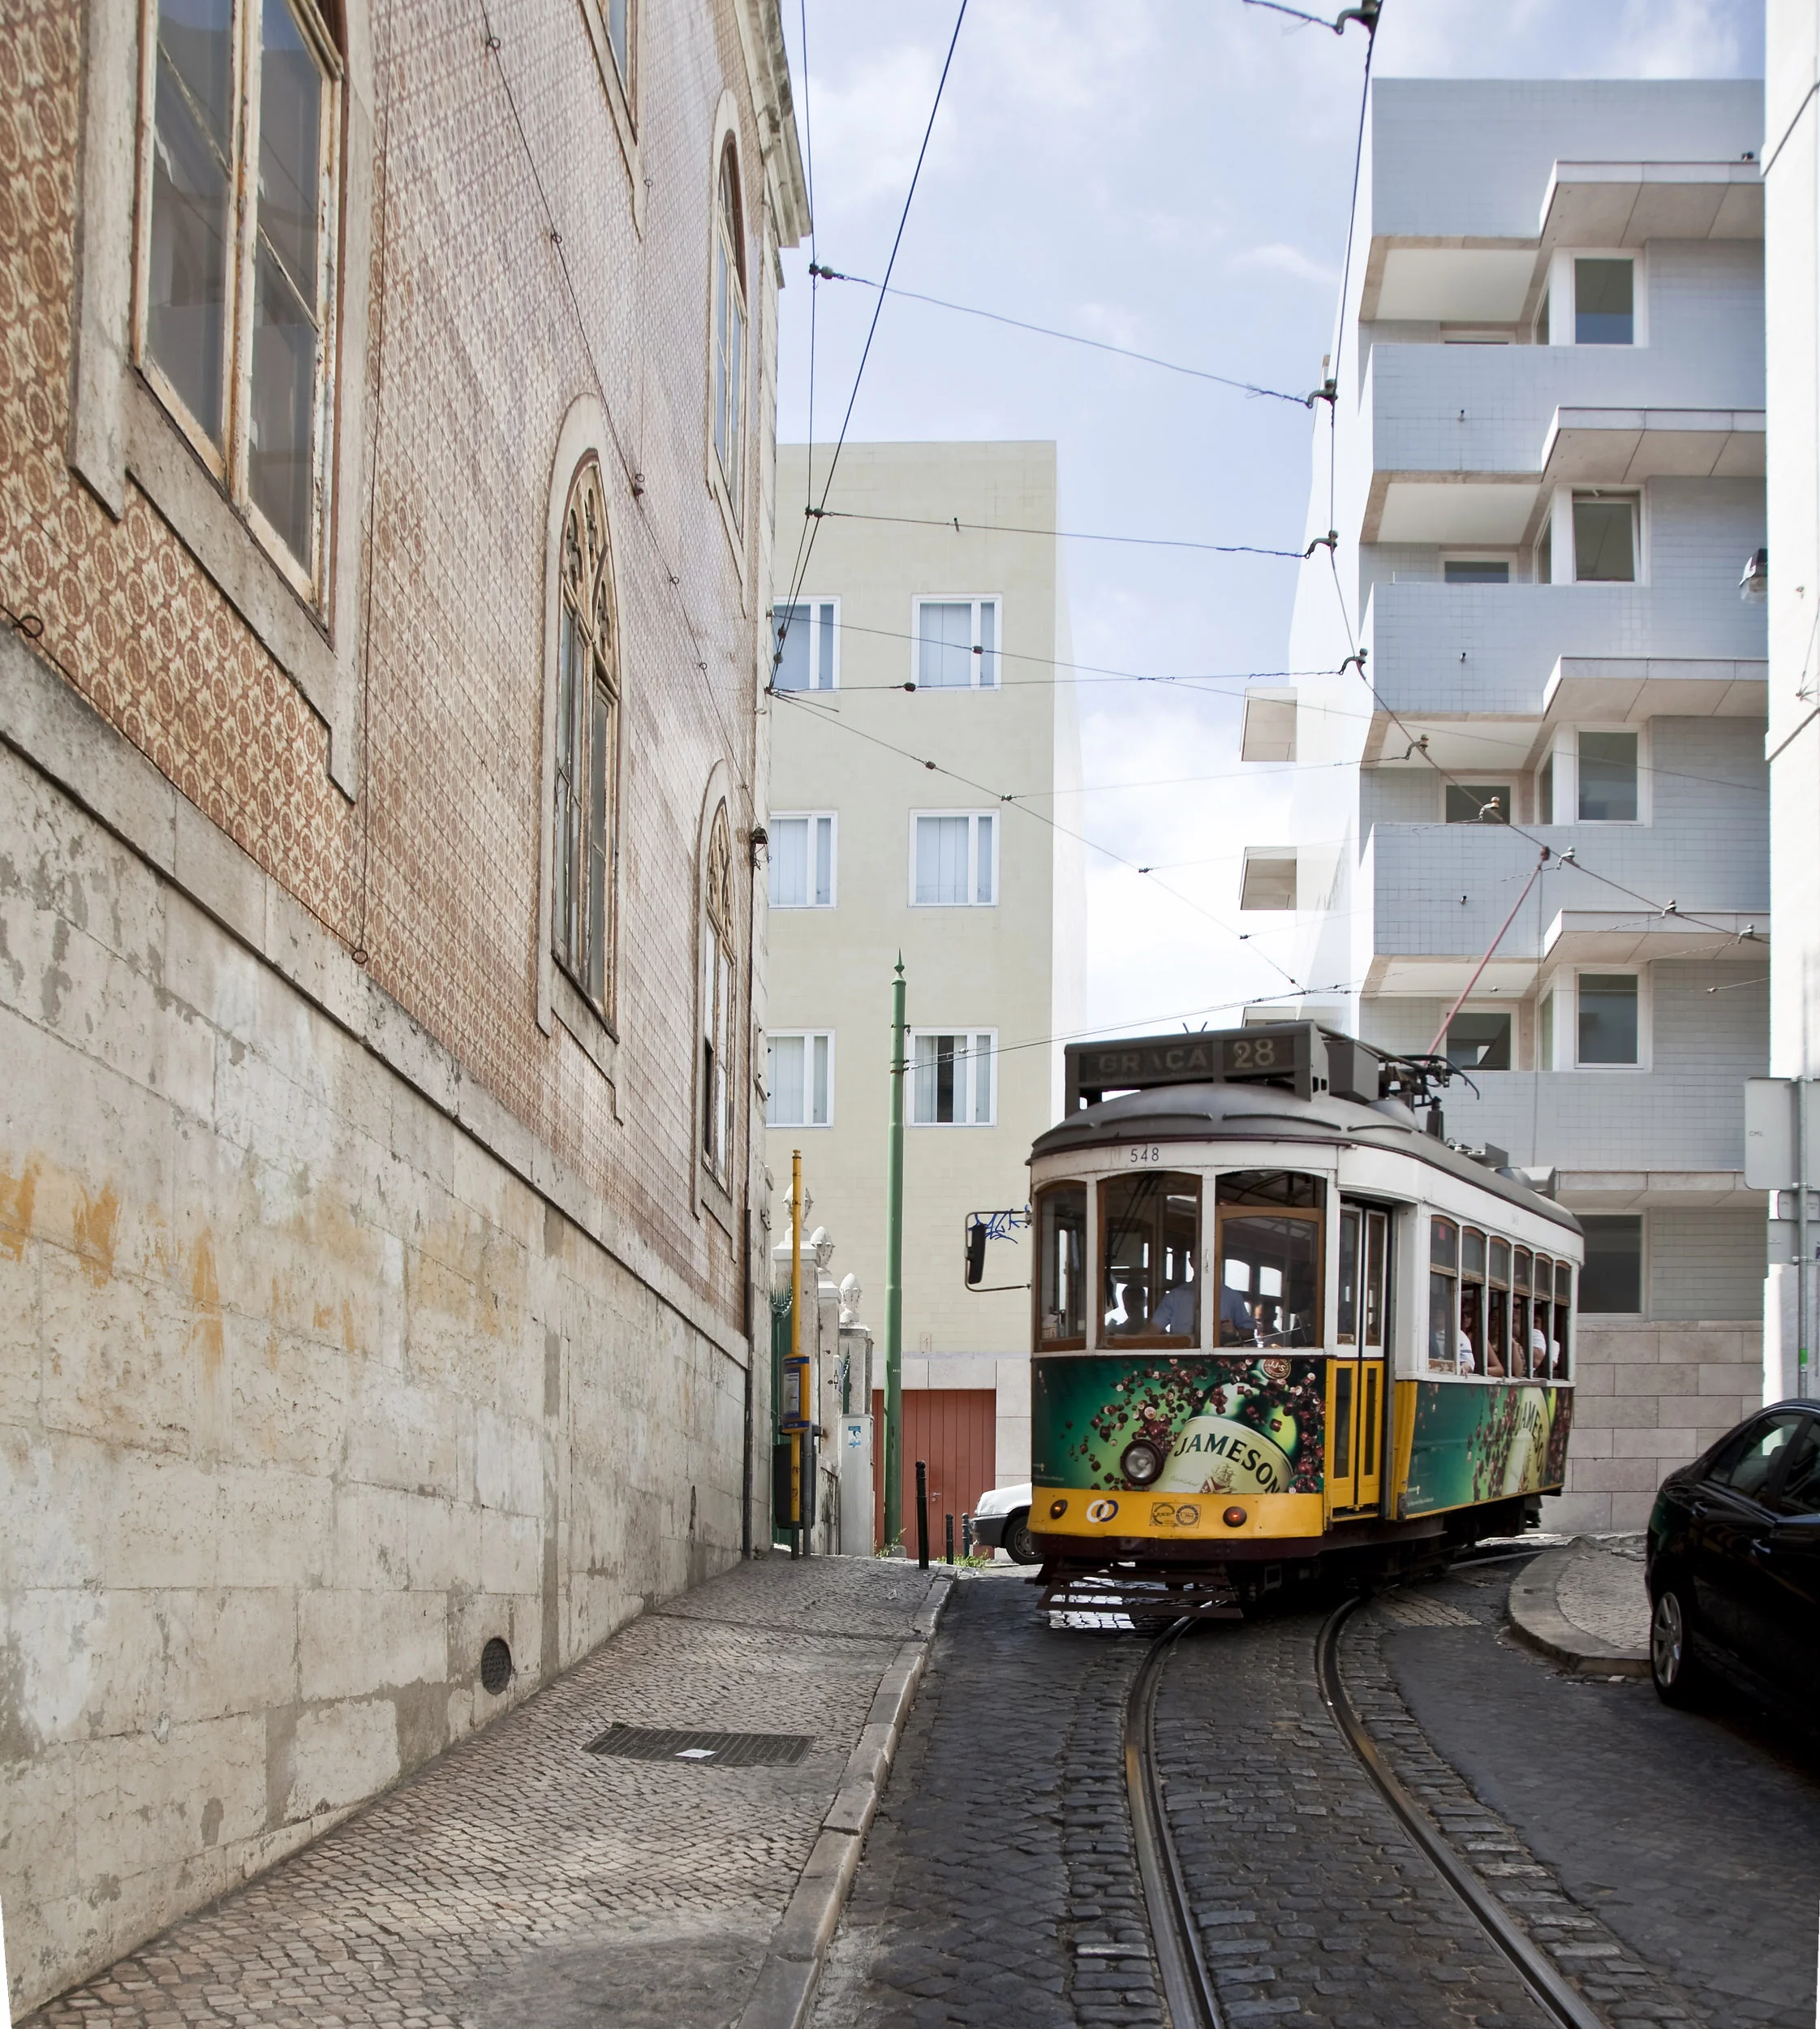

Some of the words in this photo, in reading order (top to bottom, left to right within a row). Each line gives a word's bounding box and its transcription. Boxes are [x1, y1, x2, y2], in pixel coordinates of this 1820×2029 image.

[1233, 1039, 1276, 1068] 28
[1130, 1147, 1160, 1163] 548
[1173, 1432, 1281, 1494] JAMESON
